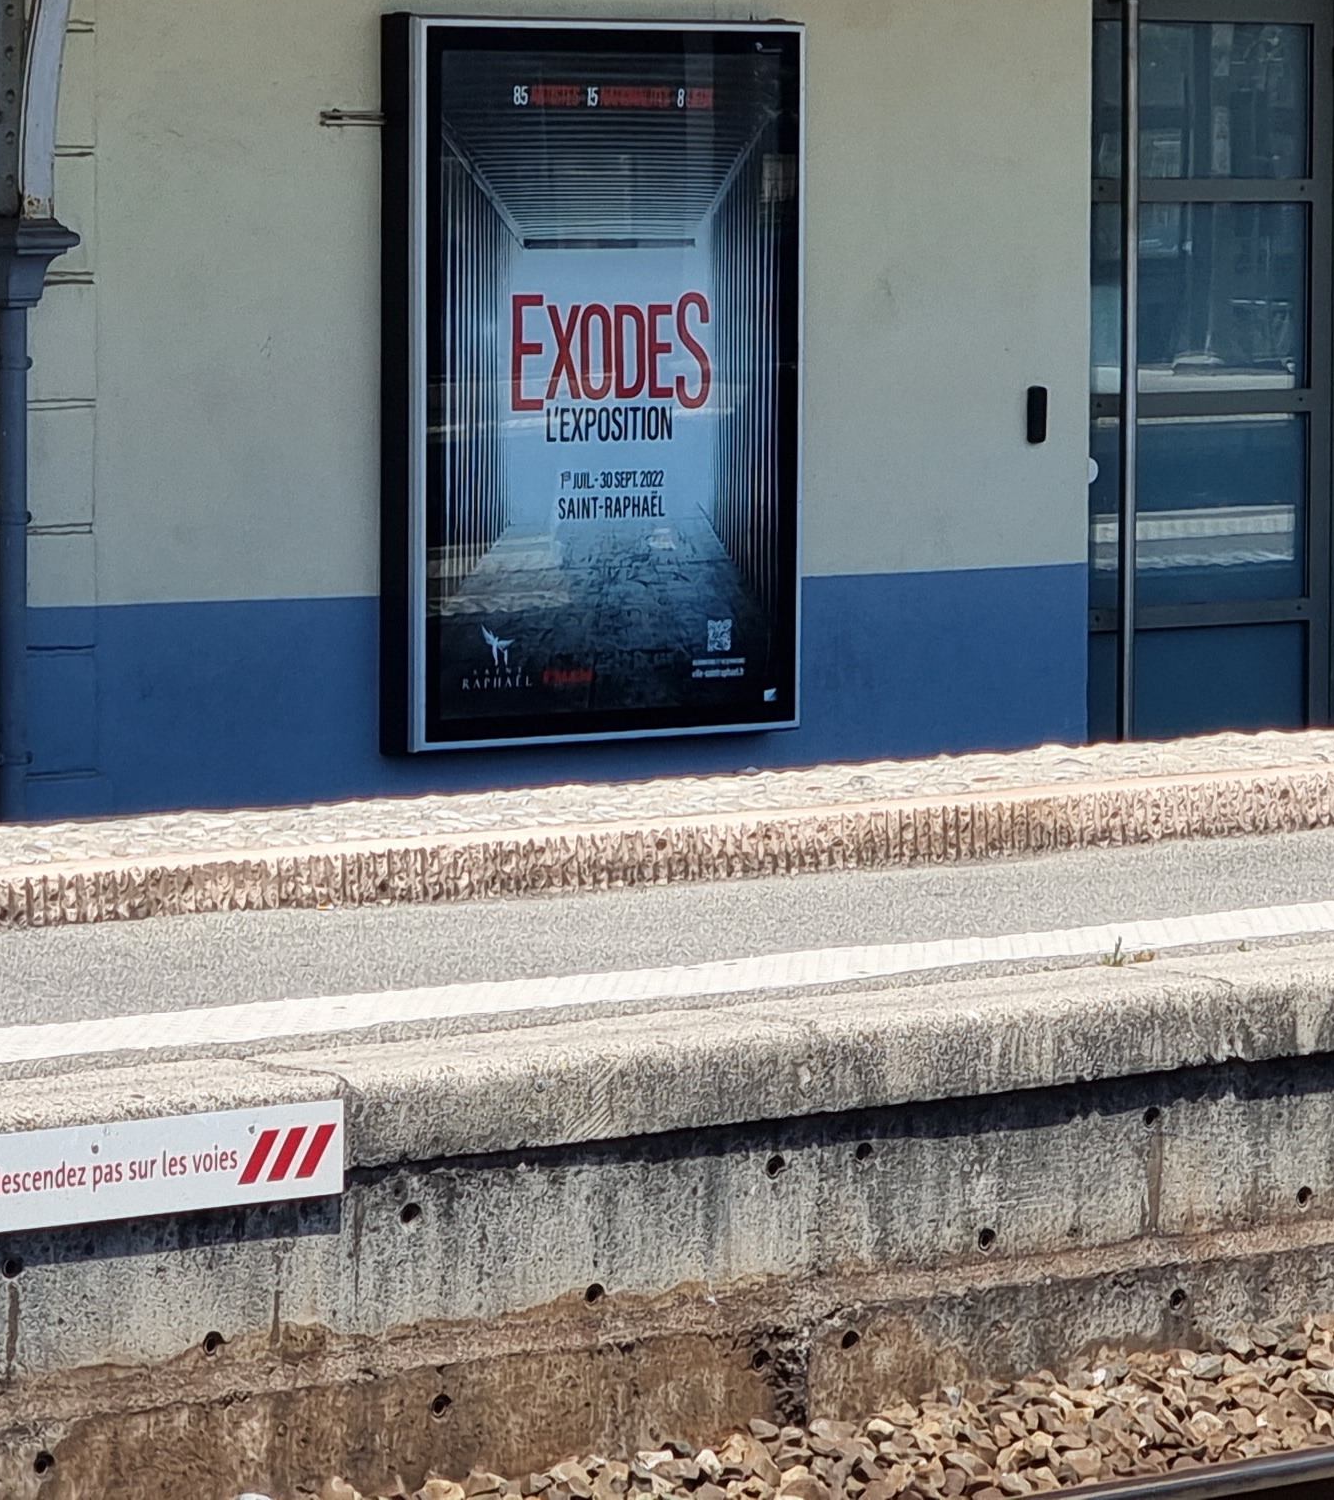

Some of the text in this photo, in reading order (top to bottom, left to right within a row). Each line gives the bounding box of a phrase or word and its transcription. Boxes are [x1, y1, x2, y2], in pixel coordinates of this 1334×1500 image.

[513, 85, 529, 106] 85
[586, 86, 599, 107] 15
[676, 88, 686, 108] 8
[511, 291, 711, 411] EXODES
[545, 406, 673, 443] L'EXPOSITION
[599, 470, 613, 489] 30
[639, 469, 665, 488] 2022
[558, 490, 666, 520] SAINT-RAPHAËL
[92, 1163, 123, 1193] pas
[128, 1157, 159, 1182] sur
[161, 1150, 188, 1178] les
[192, 1145, 239, 1174] voies
